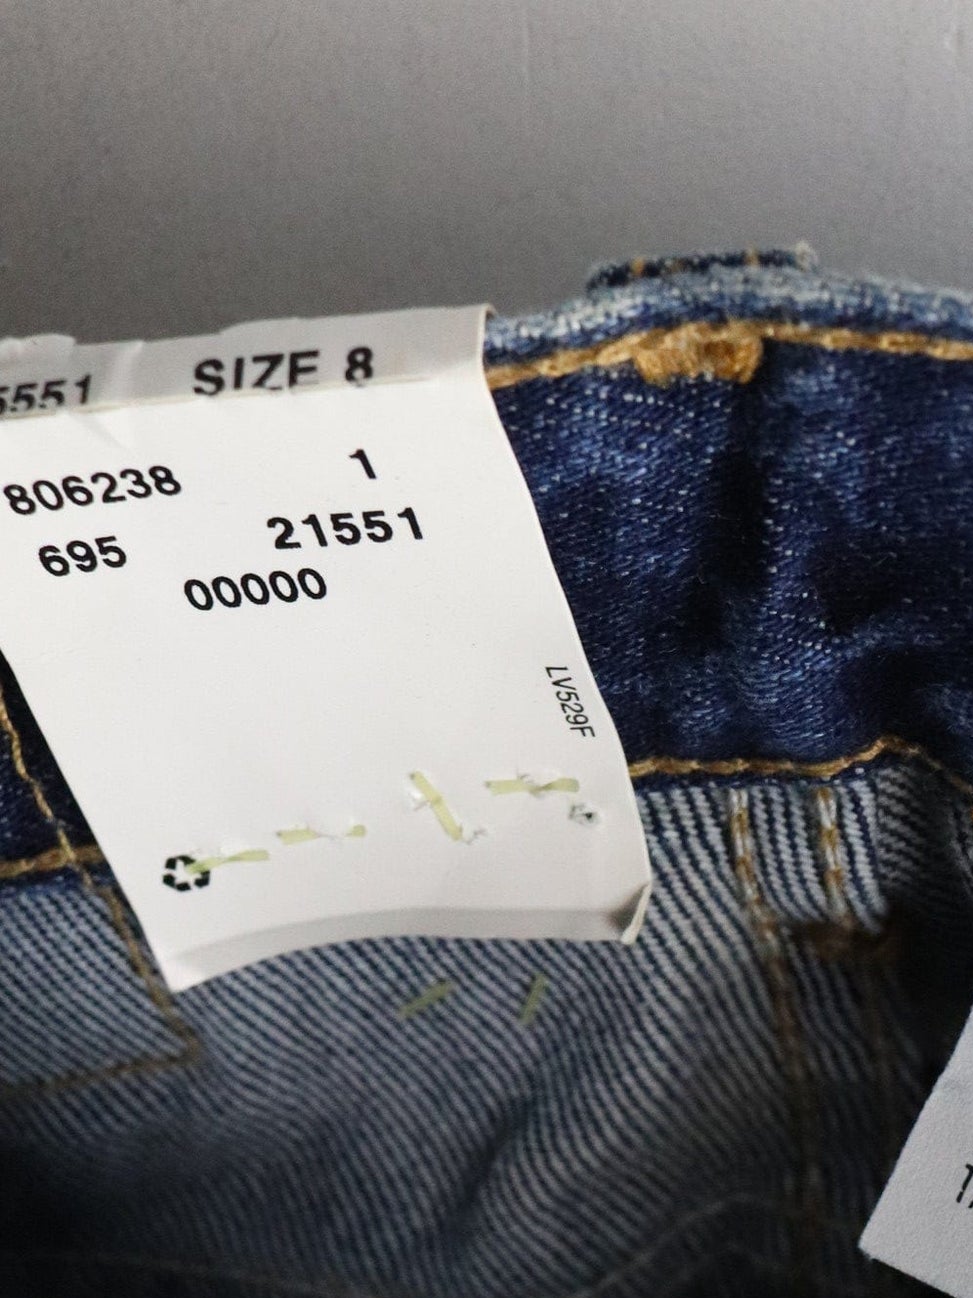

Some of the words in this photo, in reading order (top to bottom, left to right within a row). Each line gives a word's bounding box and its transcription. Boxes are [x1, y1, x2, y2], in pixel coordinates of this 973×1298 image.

[193, 350, 320, 396] SIZE
[345, 347, 373, 387] 8
[3, 465, 181, 515] 806238
[349, 448, 377, 480] 1
[38, 536, 127, 577] 695
[266, 507, 424, 550] 21551
[184, 568, 327, 611] 00000
[545, 666, 596, 738] LV529F
